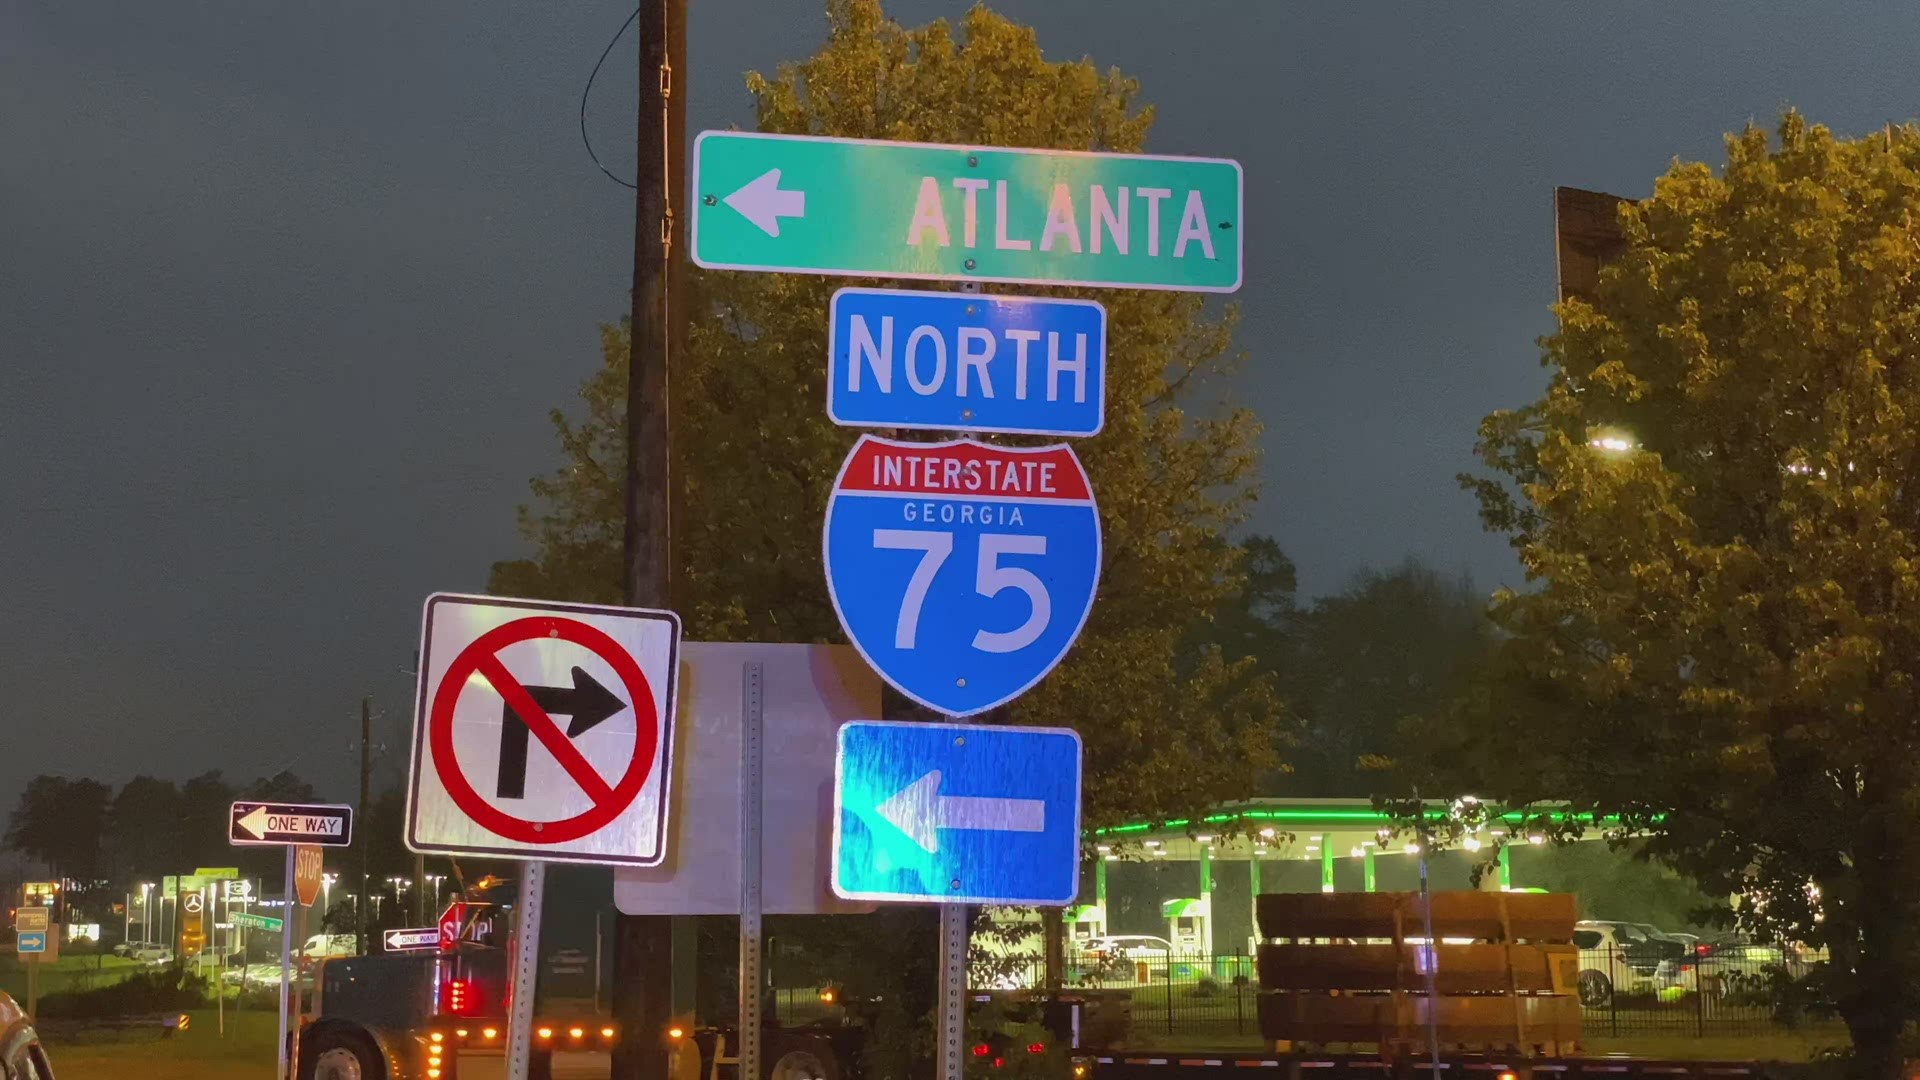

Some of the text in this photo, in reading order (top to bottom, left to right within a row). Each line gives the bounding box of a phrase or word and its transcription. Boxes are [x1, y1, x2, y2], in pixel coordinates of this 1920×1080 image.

[907, 176, 1216, 261] ATLANTA
[847, 314, 1087, 404] NORTH
[872, 454, 1057, 494] INTERSTATE
[903, 502, 1025, 527] GEORGIA
[873, 529, 1052, 654] 75
[267, 816, 338, 833] ONE WAY
[297, 848, 321, 881] STOP
[228, 912, 266, 929] Sheraton
[402, 936, 416, 944] ONE
